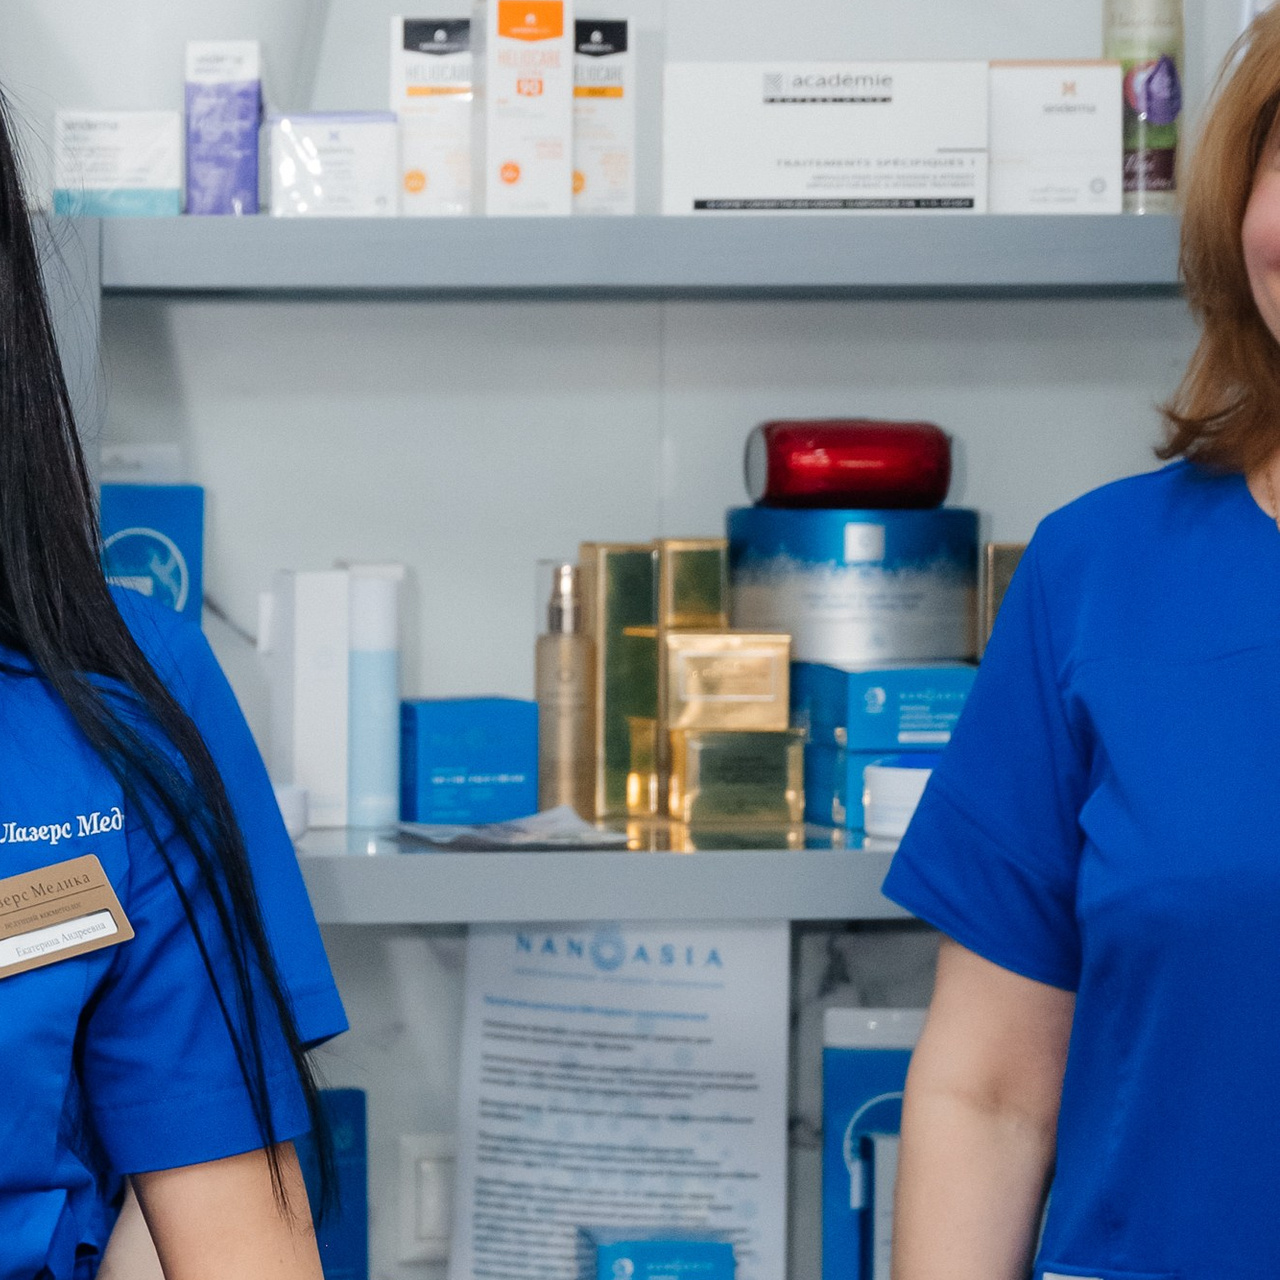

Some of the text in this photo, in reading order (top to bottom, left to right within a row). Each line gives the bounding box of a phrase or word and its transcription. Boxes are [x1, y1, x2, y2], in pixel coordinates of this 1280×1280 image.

[0, 806, 125, 845] Лазерс Мед
[30, 872, 91, 899] Медика
[15, 921, 107, 958] Екатерина Андреевна
